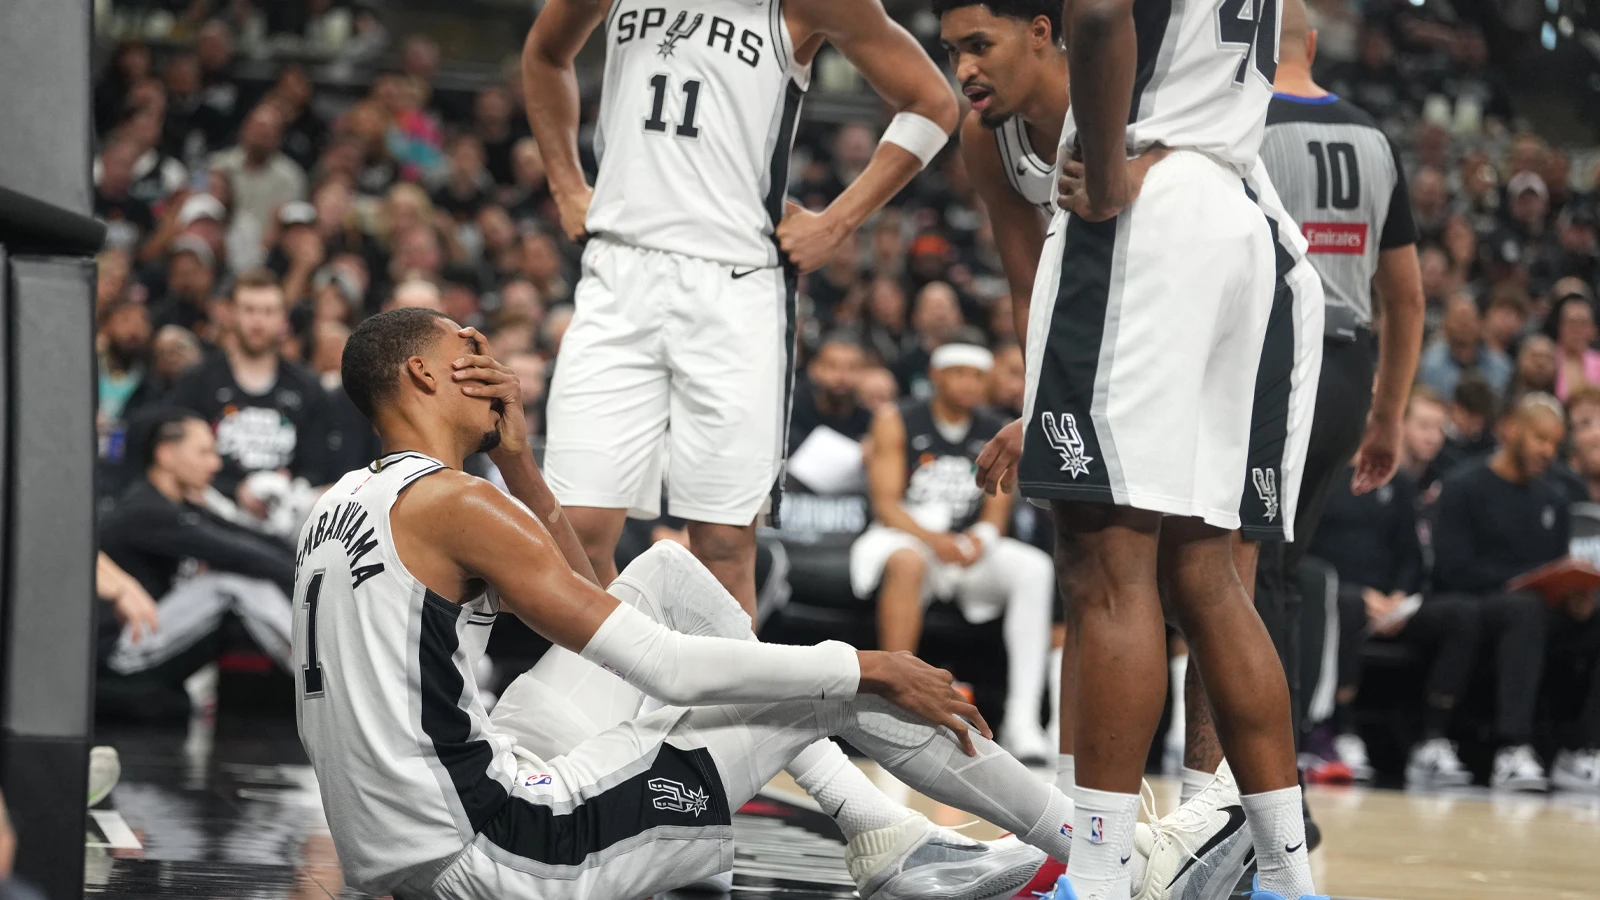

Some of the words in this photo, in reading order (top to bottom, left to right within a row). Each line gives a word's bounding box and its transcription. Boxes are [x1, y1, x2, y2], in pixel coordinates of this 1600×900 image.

[643, 73, 702, 141] 11
[1307, 141, 1360, 211] 10
[1306, 229, 1361, 247] Emirates
[301, 568, 326, 699] 1
